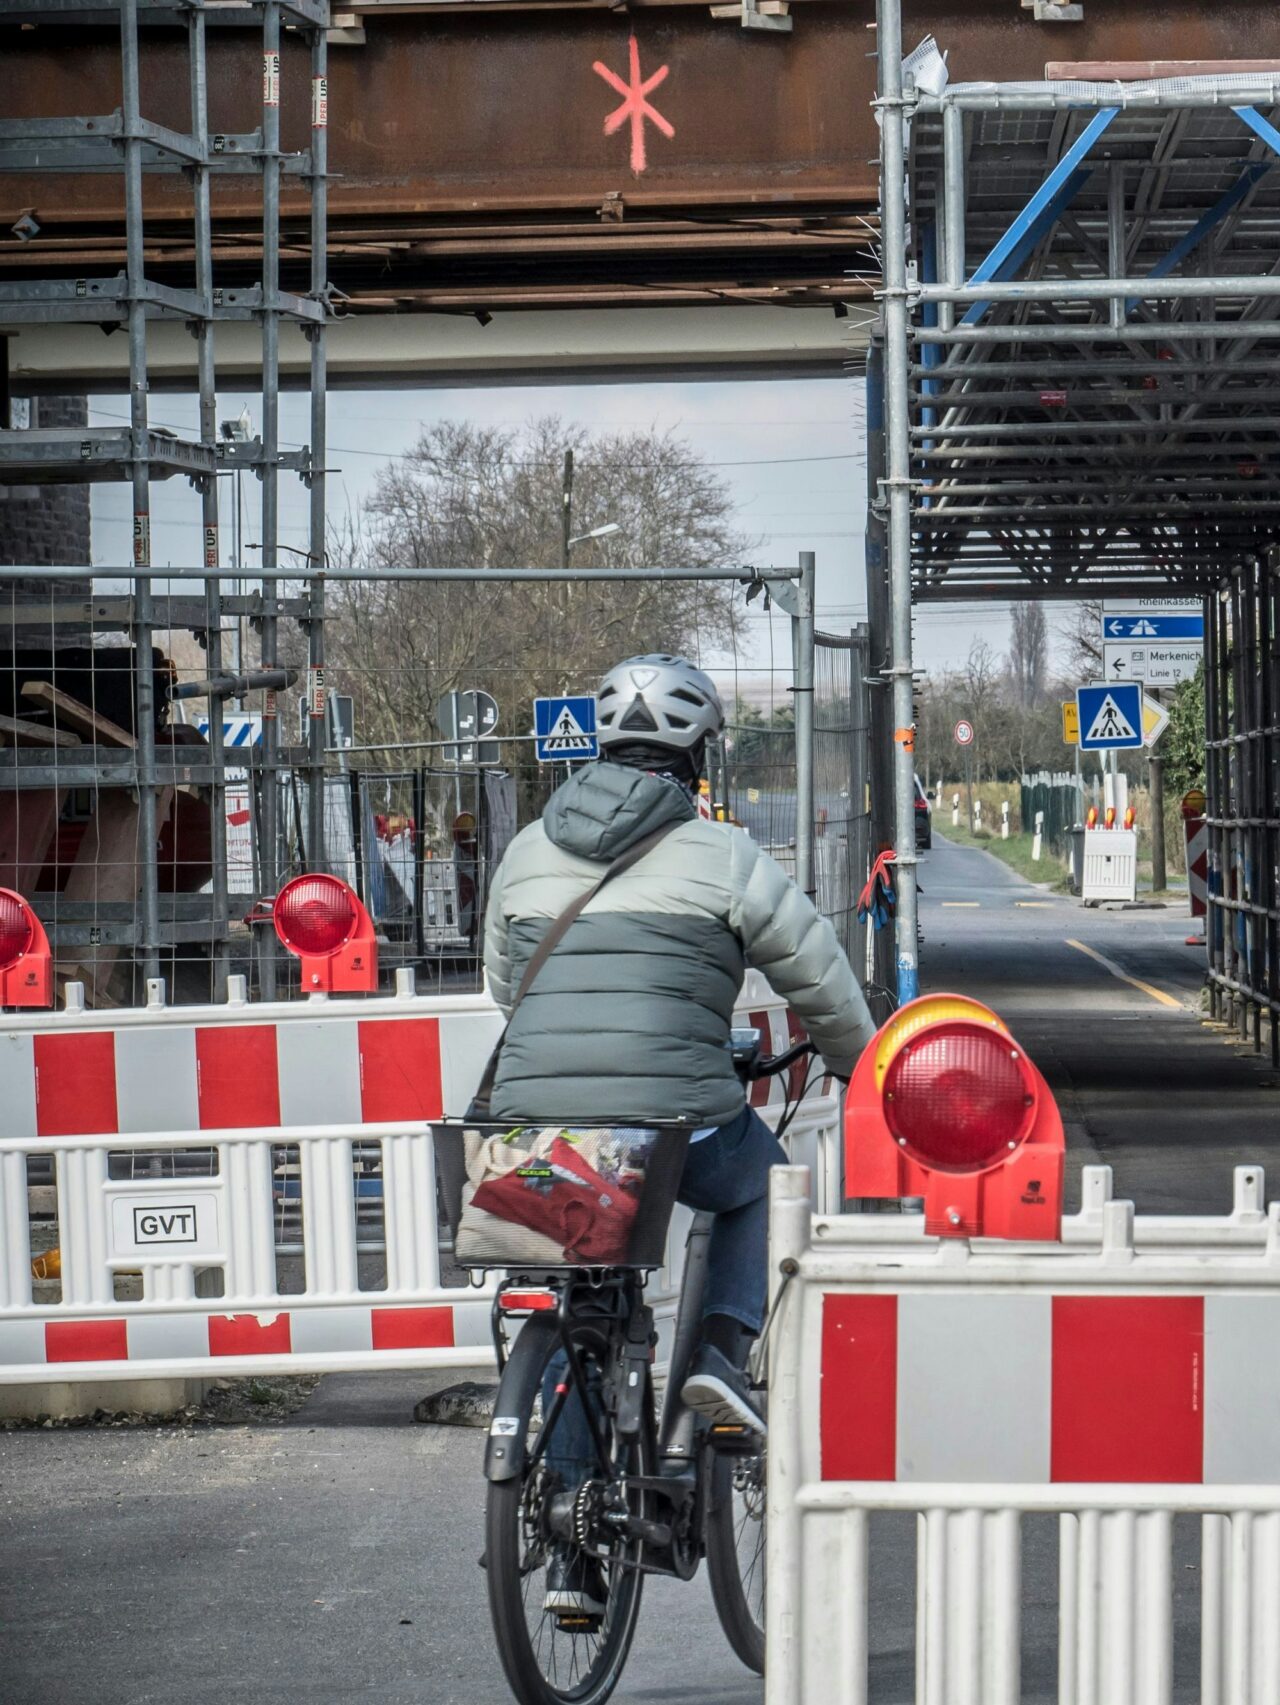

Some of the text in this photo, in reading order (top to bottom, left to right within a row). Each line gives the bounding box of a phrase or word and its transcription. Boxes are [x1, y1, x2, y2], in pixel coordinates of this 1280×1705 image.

[206, 529, 216, 546] UP
[1150, 652, 1201, 661] Merkenich
[316, 669, 324, 686] UP
[1150, 669, 1181, 678] Linie 12
[959, 727, 969, 738] 50
[140, 1214, 192, 1236] GVT
